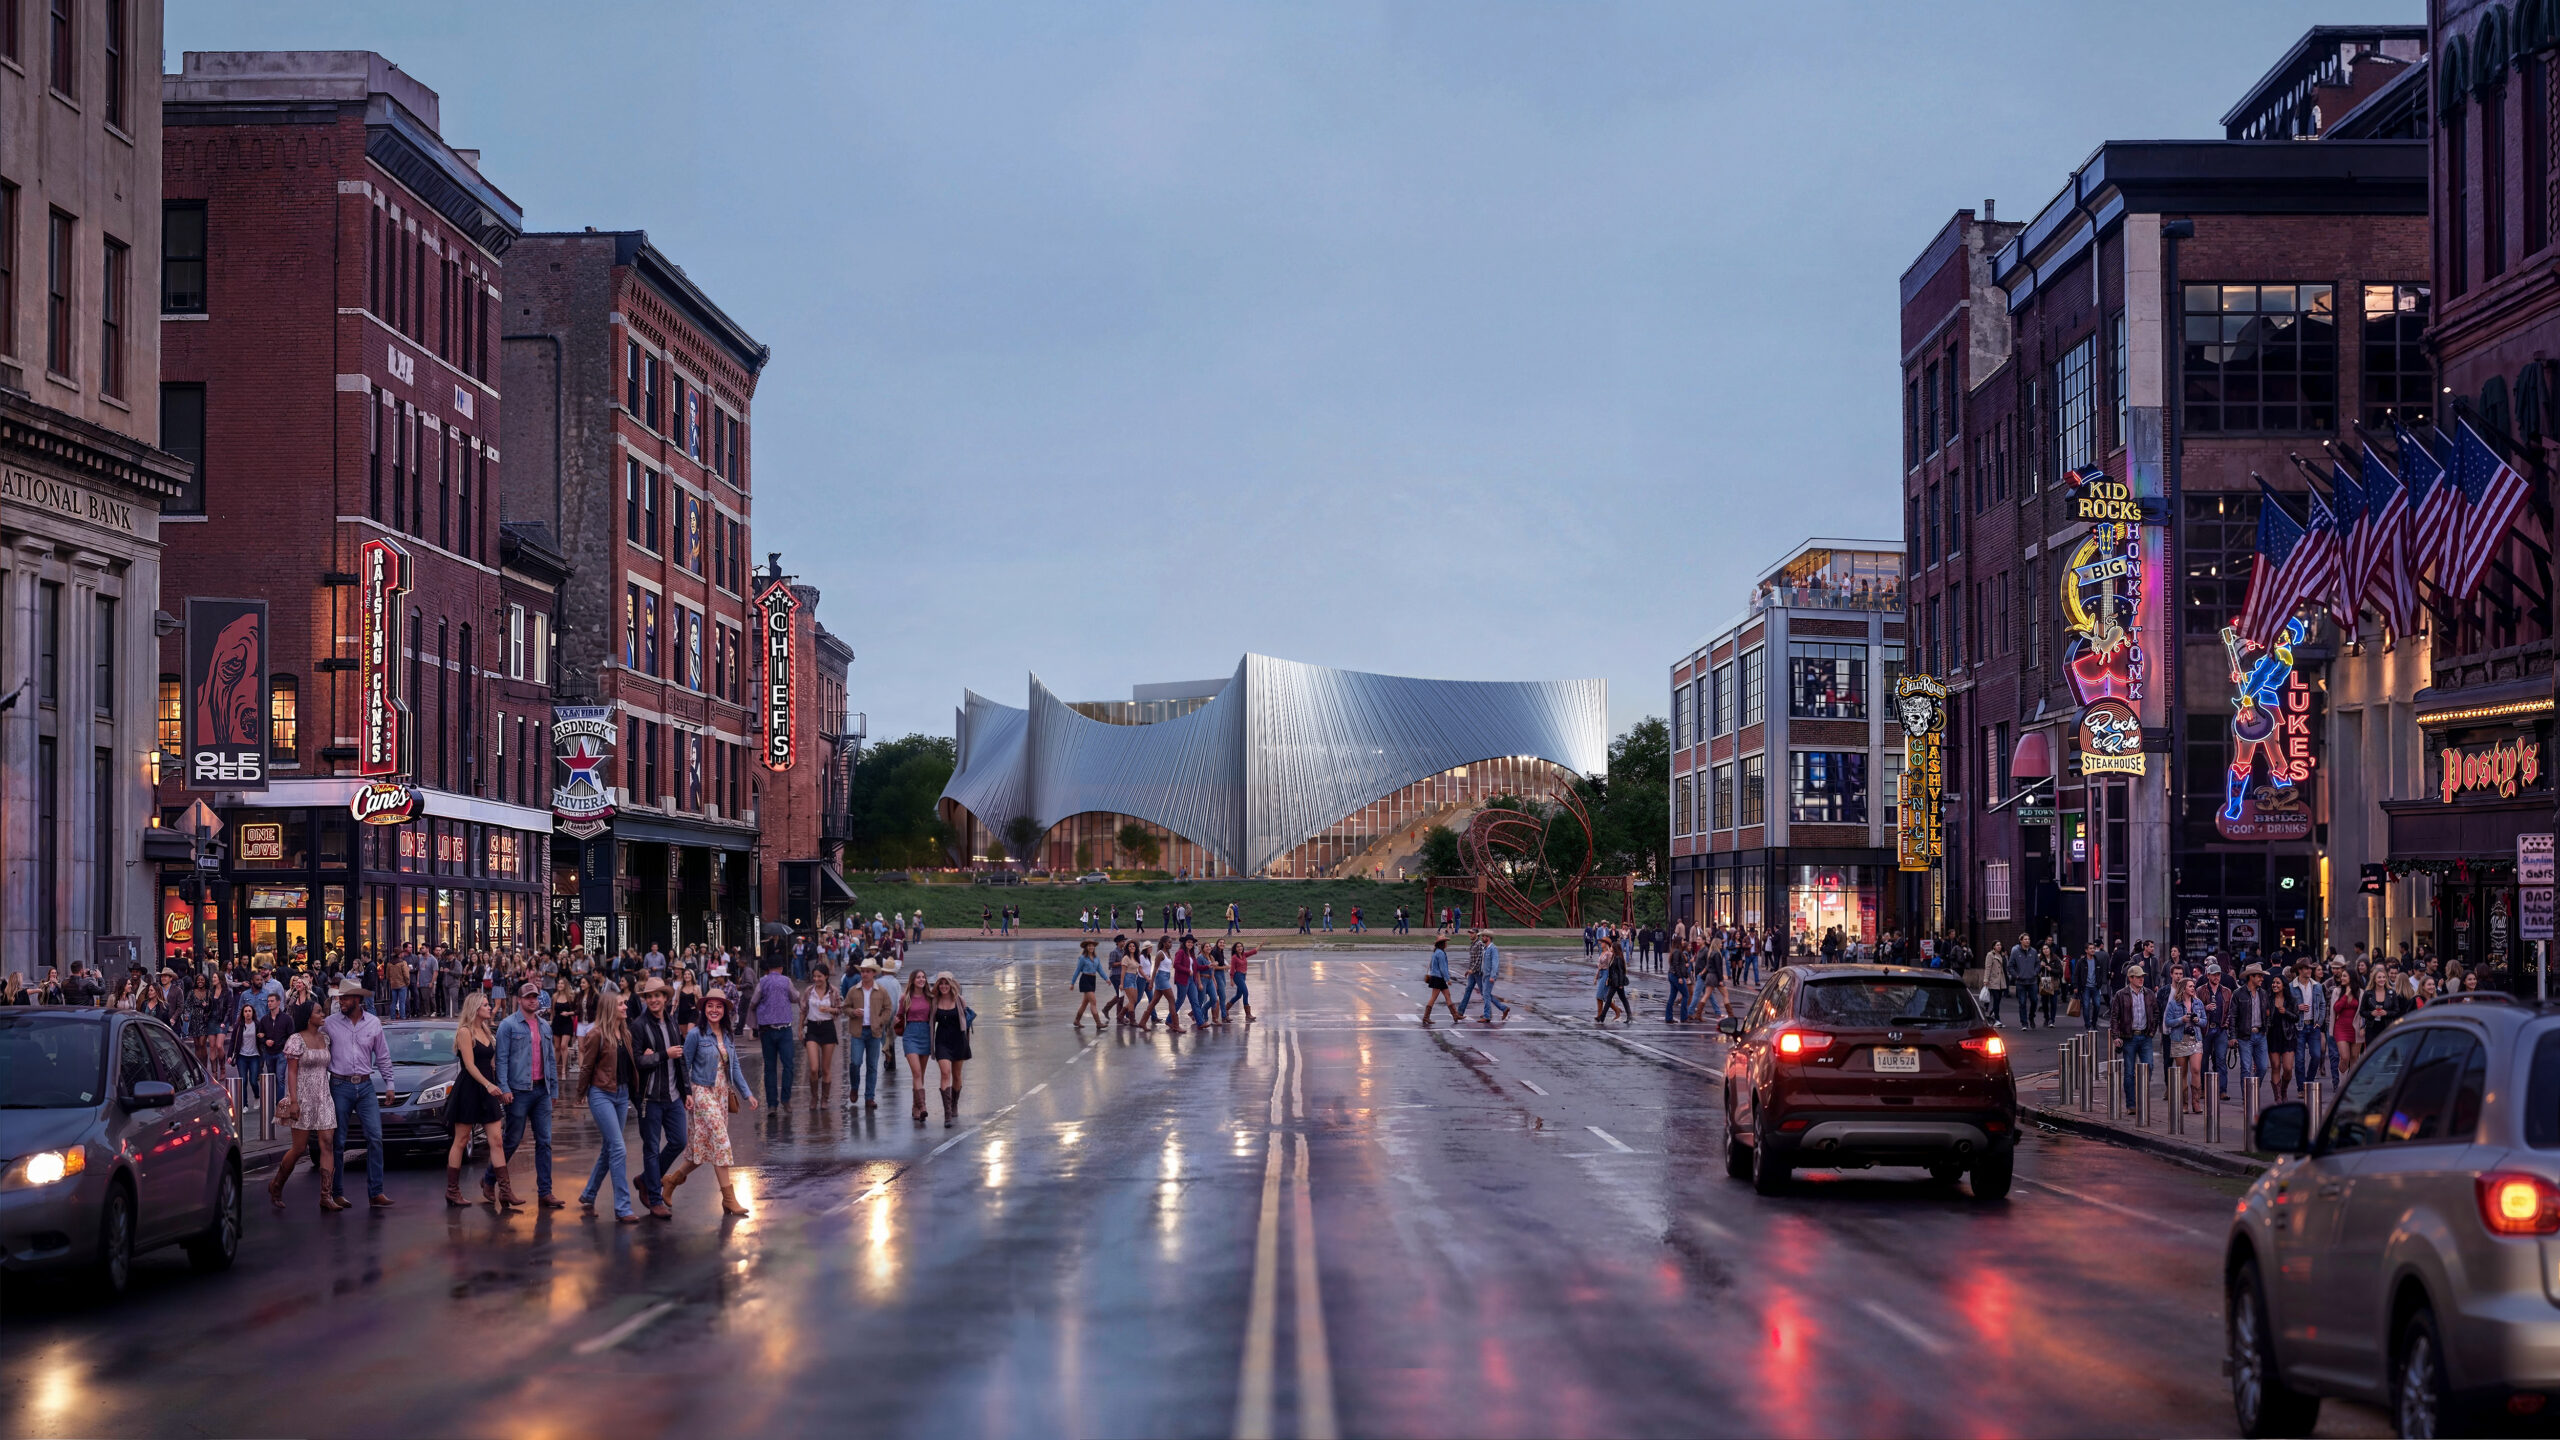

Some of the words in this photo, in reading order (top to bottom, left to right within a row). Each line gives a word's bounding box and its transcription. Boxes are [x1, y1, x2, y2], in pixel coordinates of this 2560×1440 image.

[1, 468, 82, 514] ATIONAL
[88, 495, 132, 530] BANK
[2089, 481, 2128, 500] KID
[2091, 559, 2123, 580] BIG
[2125, 522, 2141, 615] HONKY
[373, 548, 383, 664] RAISING
[2127, 626, 2144, 699] TONK
[769, 611, 789, 756] CHIEFS
[554, 720, 609, 738] REDNECK
[2084, 710, 2140, 735] Rock
[2101, 733, 2141, 753] Roll
[194, 751, 261, 767] OLE
[2084, 755, 2142, 771] STEAKHOUSE
[195, 765, 261, 780] RED
[352, 784, 410, 821] Cane's
[555, 794, 608, 810] RIVIERA
[2254, 785, 2299, 811] 32
[247, 828, 275, 841] ONE
[2267, 824, 2307, 833] DRINKS
[243, 843, 279, 856] LOVE
[437, 834, 463, 862] LOE
[165, 912, 193, 939] Cane's
